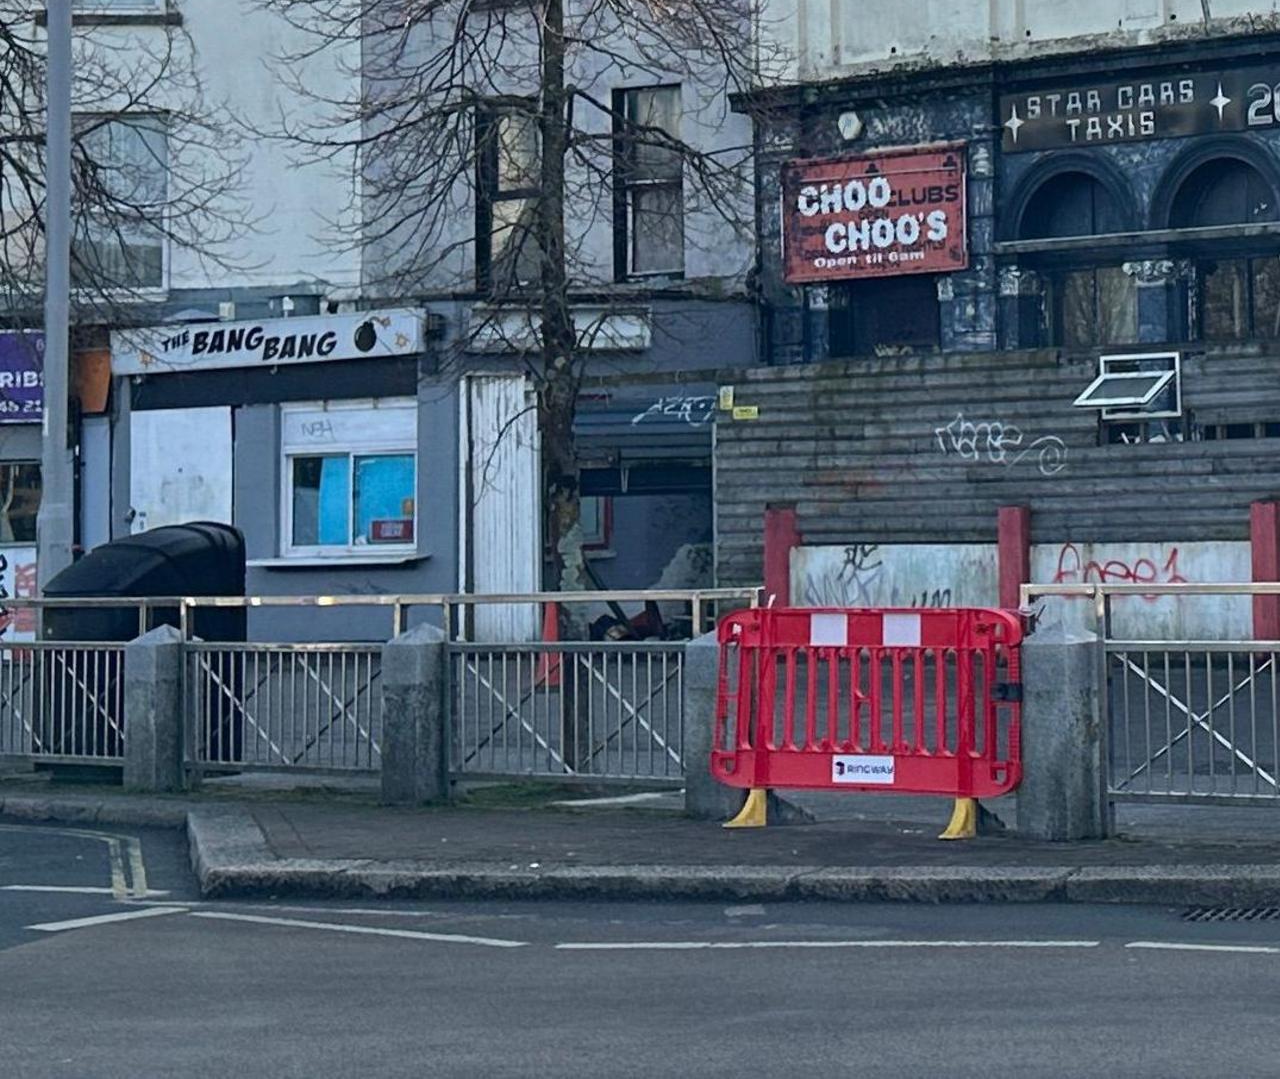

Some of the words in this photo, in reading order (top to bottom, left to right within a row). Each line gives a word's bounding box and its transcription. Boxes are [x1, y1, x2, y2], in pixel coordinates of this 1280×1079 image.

[1027, 91, 1101, 120] STAR
[1118, 79, 1194, 110] CARS
[1067, 111, 1155, 141] TAXIS
[798, 177, 891, 216] CHOO
[825, 210, 948, 253] CHOO'S
[814, 255, 857, 269] Open
[161, 330, 189, 352] THE
[192, 326, 264, 355] BANG
[262, 331, 337, 361] BANG
